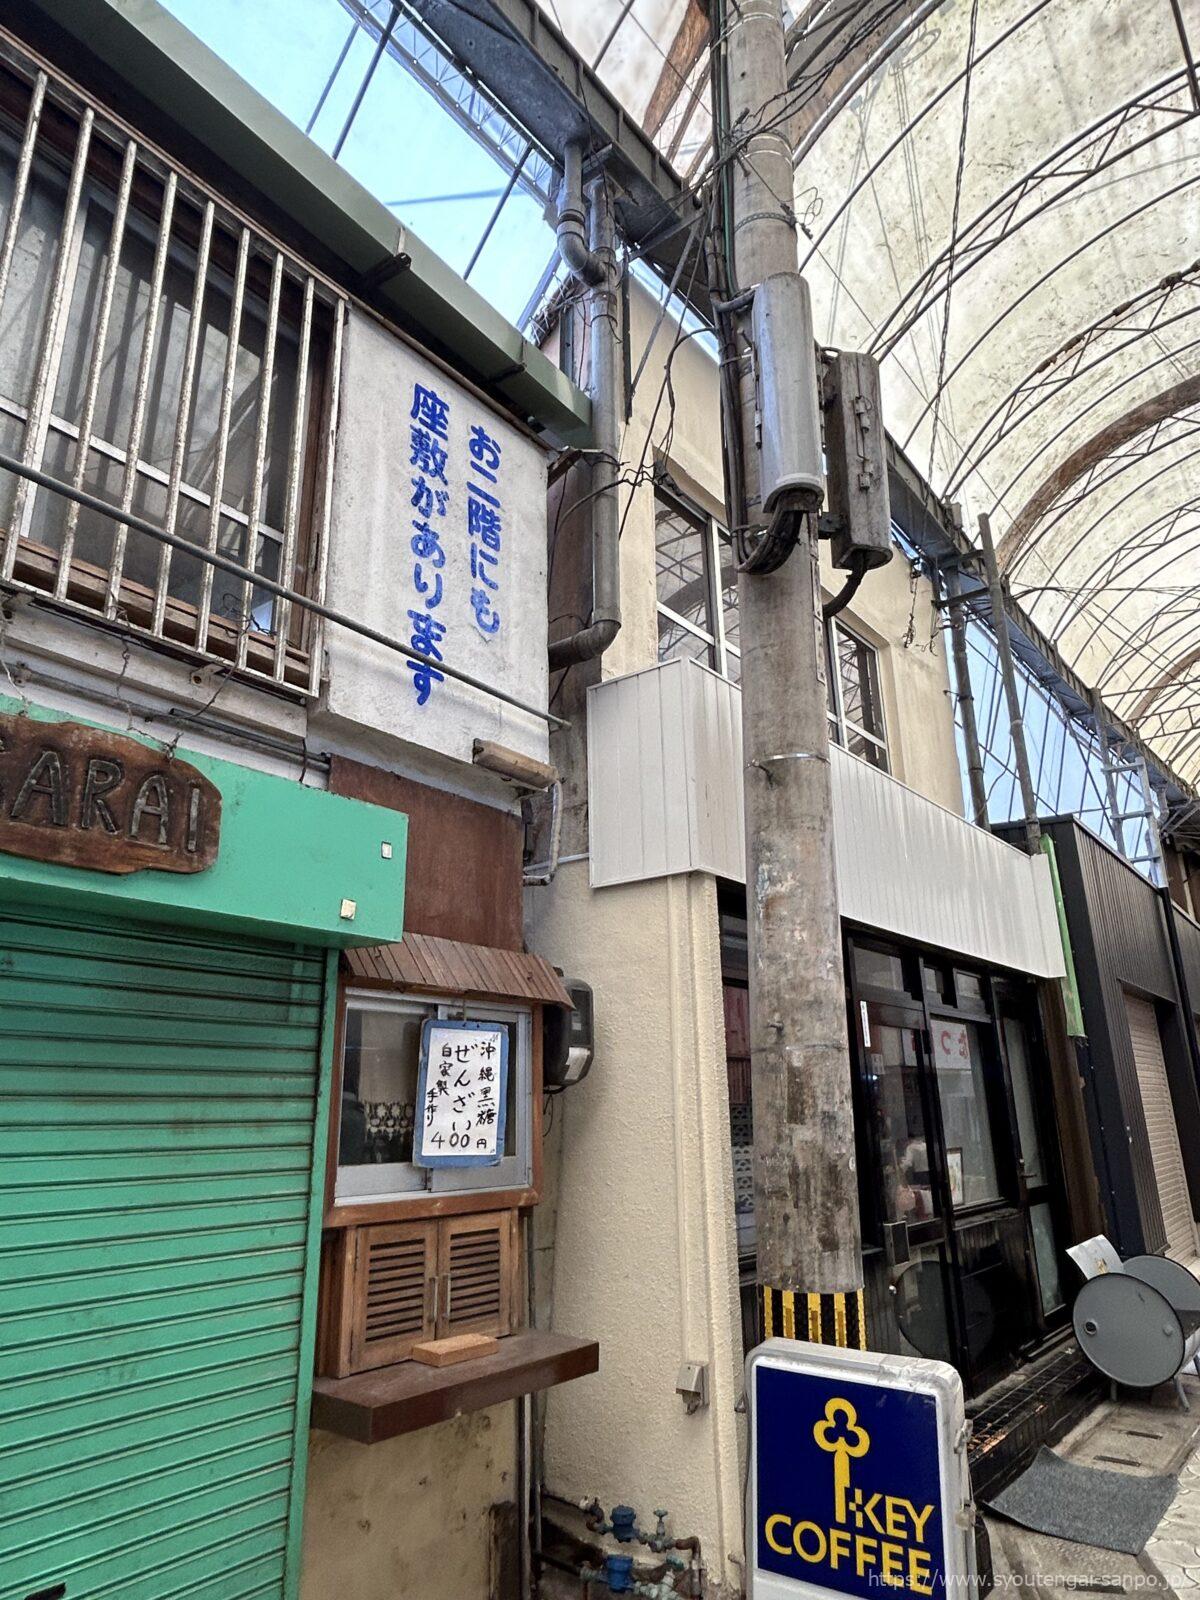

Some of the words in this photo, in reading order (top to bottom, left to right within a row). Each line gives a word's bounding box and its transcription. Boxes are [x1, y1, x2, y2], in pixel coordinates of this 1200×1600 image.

[407, 383, 449, 705] 座敷があります
[467, 426, 501, 634] お二階にも
[0, 738, 201, 851] ARAI
[452, 1043, 478, 1132] ぜんざい
[476, 1042, 496, 1126] 沖縄黒糖
[765, 1514, 933, 1595] COFFEE
[849, 1488, 934, 1543] KEY
